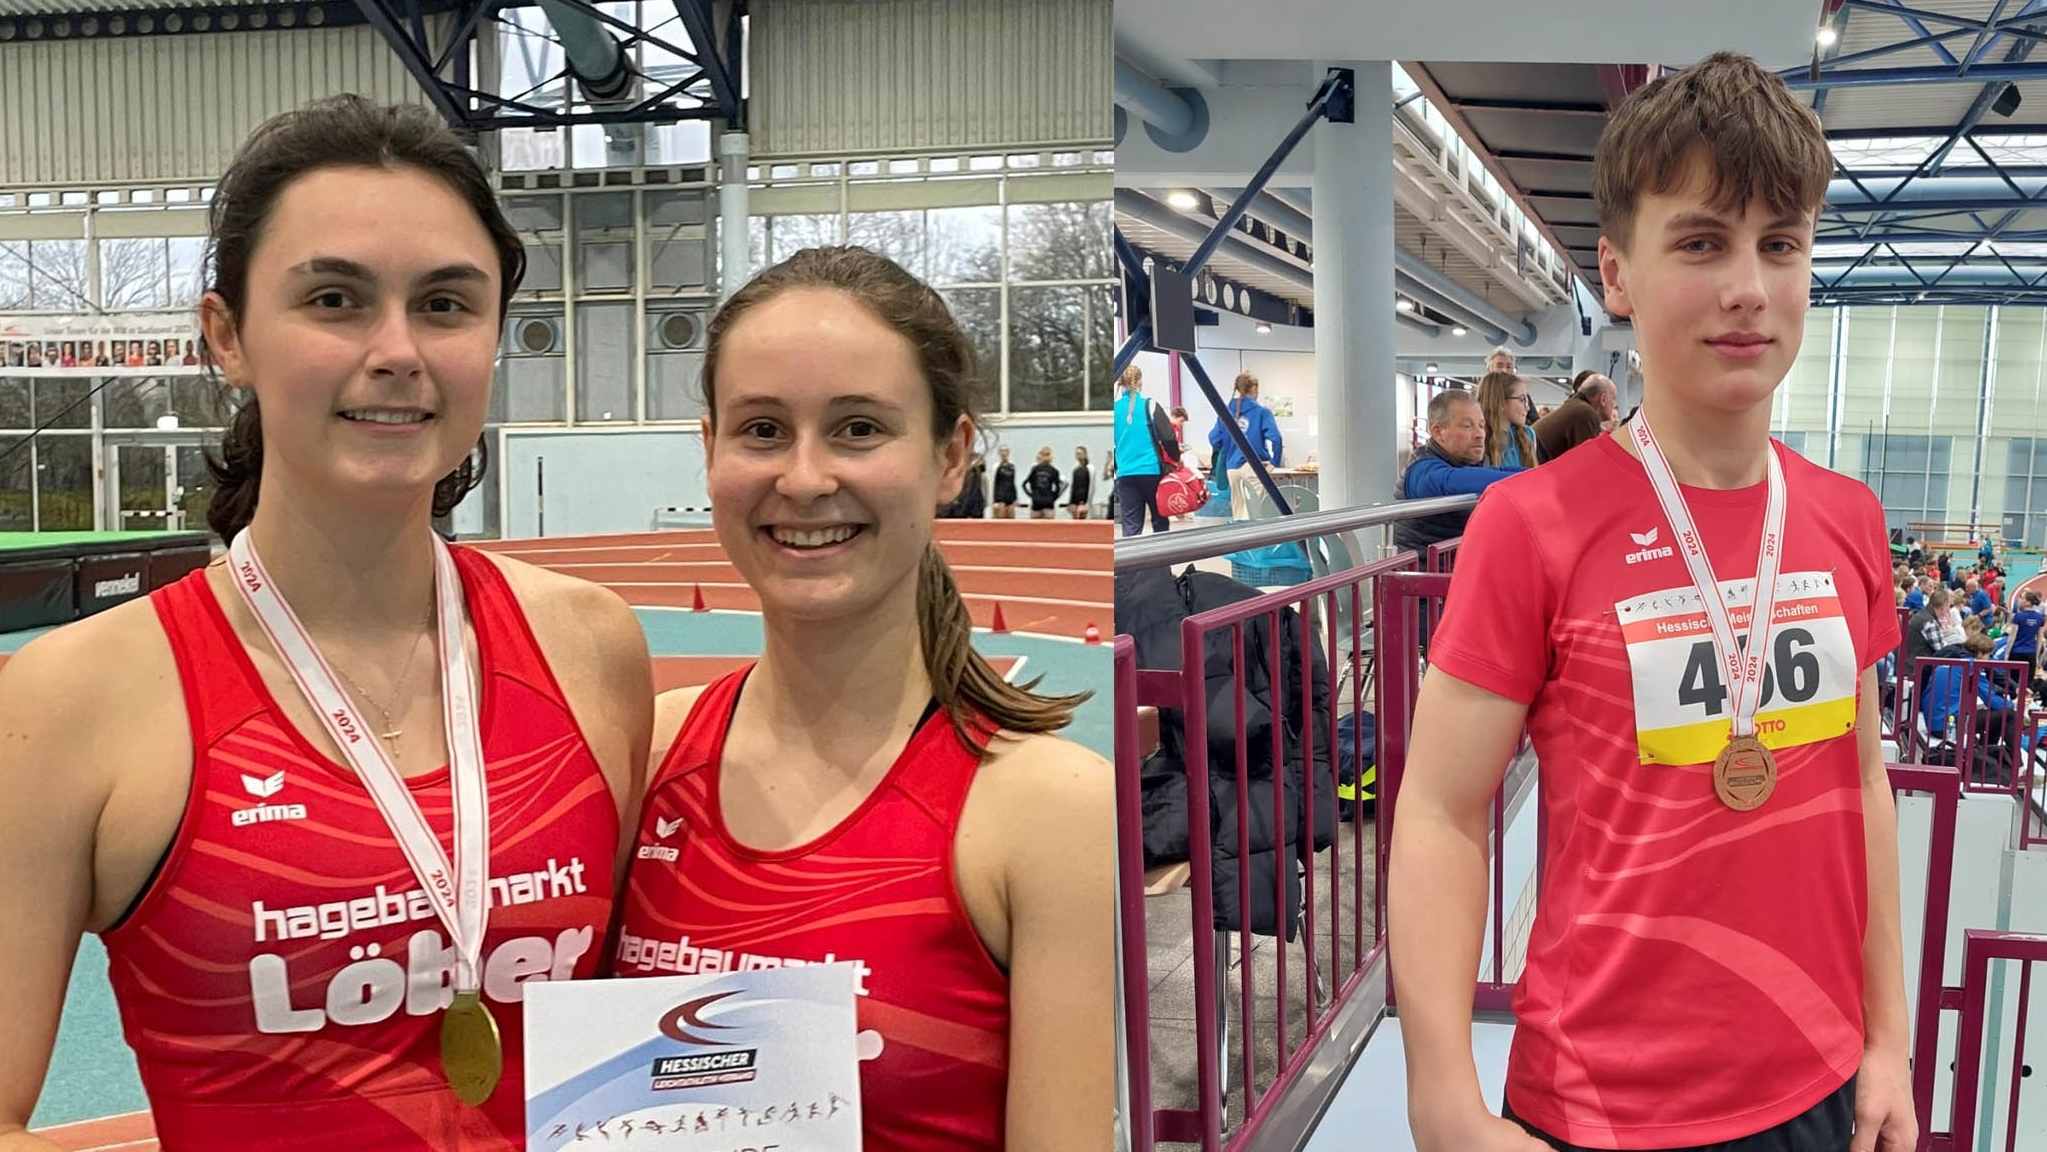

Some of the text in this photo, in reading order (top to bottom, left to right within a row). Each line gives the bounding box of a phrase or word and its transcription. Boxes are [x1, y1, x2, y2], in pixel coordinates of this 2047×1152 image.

[1636, 425, 1650, 447] 2024
[1625, 546, 1673, 564] erima
[1683, 530, 1698, 556] 2024
[1766, 533, 1775, 557] 2024
[240, 561, 262, 593] 2024
[1728, 653, 1740, 680] 2024
[1747, 656, 1758, 682] 2024
[332, 709, 360, 744] 2024
[231, 802, 307, 826] erima
[637, 843, 679, 862] erima
[252, 856, 586, 942] hagebamarkt
[249, 924, 594, 1034] Löber
[660, 1052, 750, 1074] HESSISCHER
